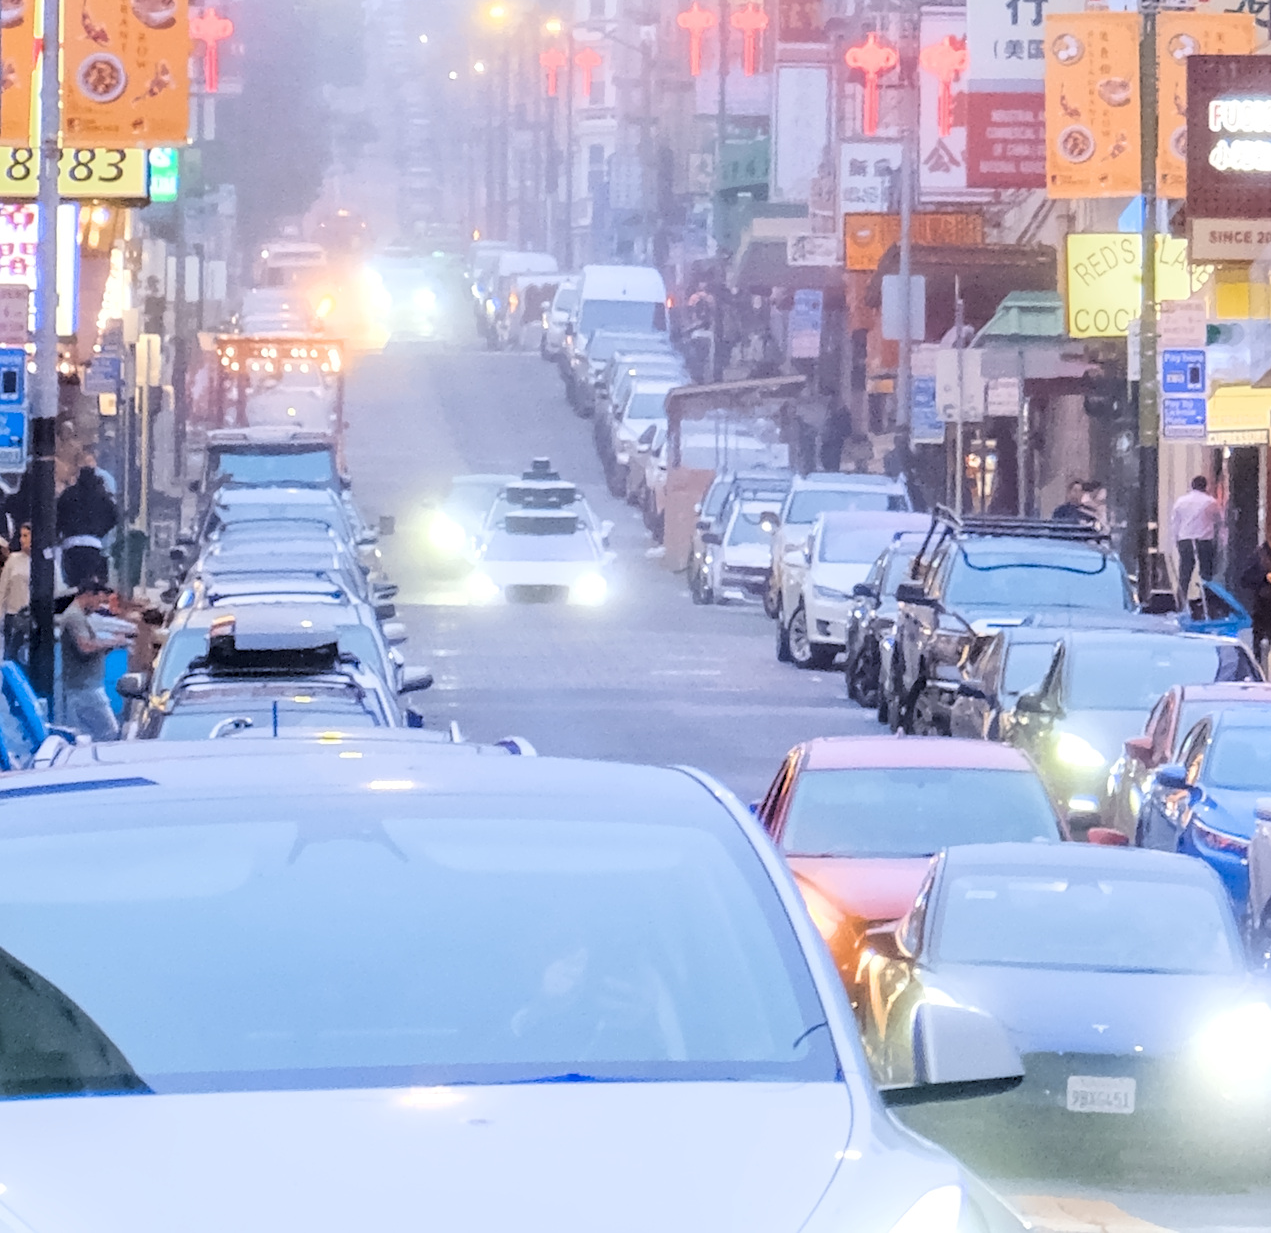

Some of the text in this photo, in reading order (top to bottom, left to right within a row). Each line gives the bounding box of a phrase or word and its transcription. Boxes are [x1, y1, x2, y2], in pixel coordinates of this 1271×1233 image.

[6, 147, 126, 182] 883
[1208, 230, 1253, 244] SINCE
[1073, 238, 1136, 286] RED'S
[1074, 308, 1138, 333] COC
